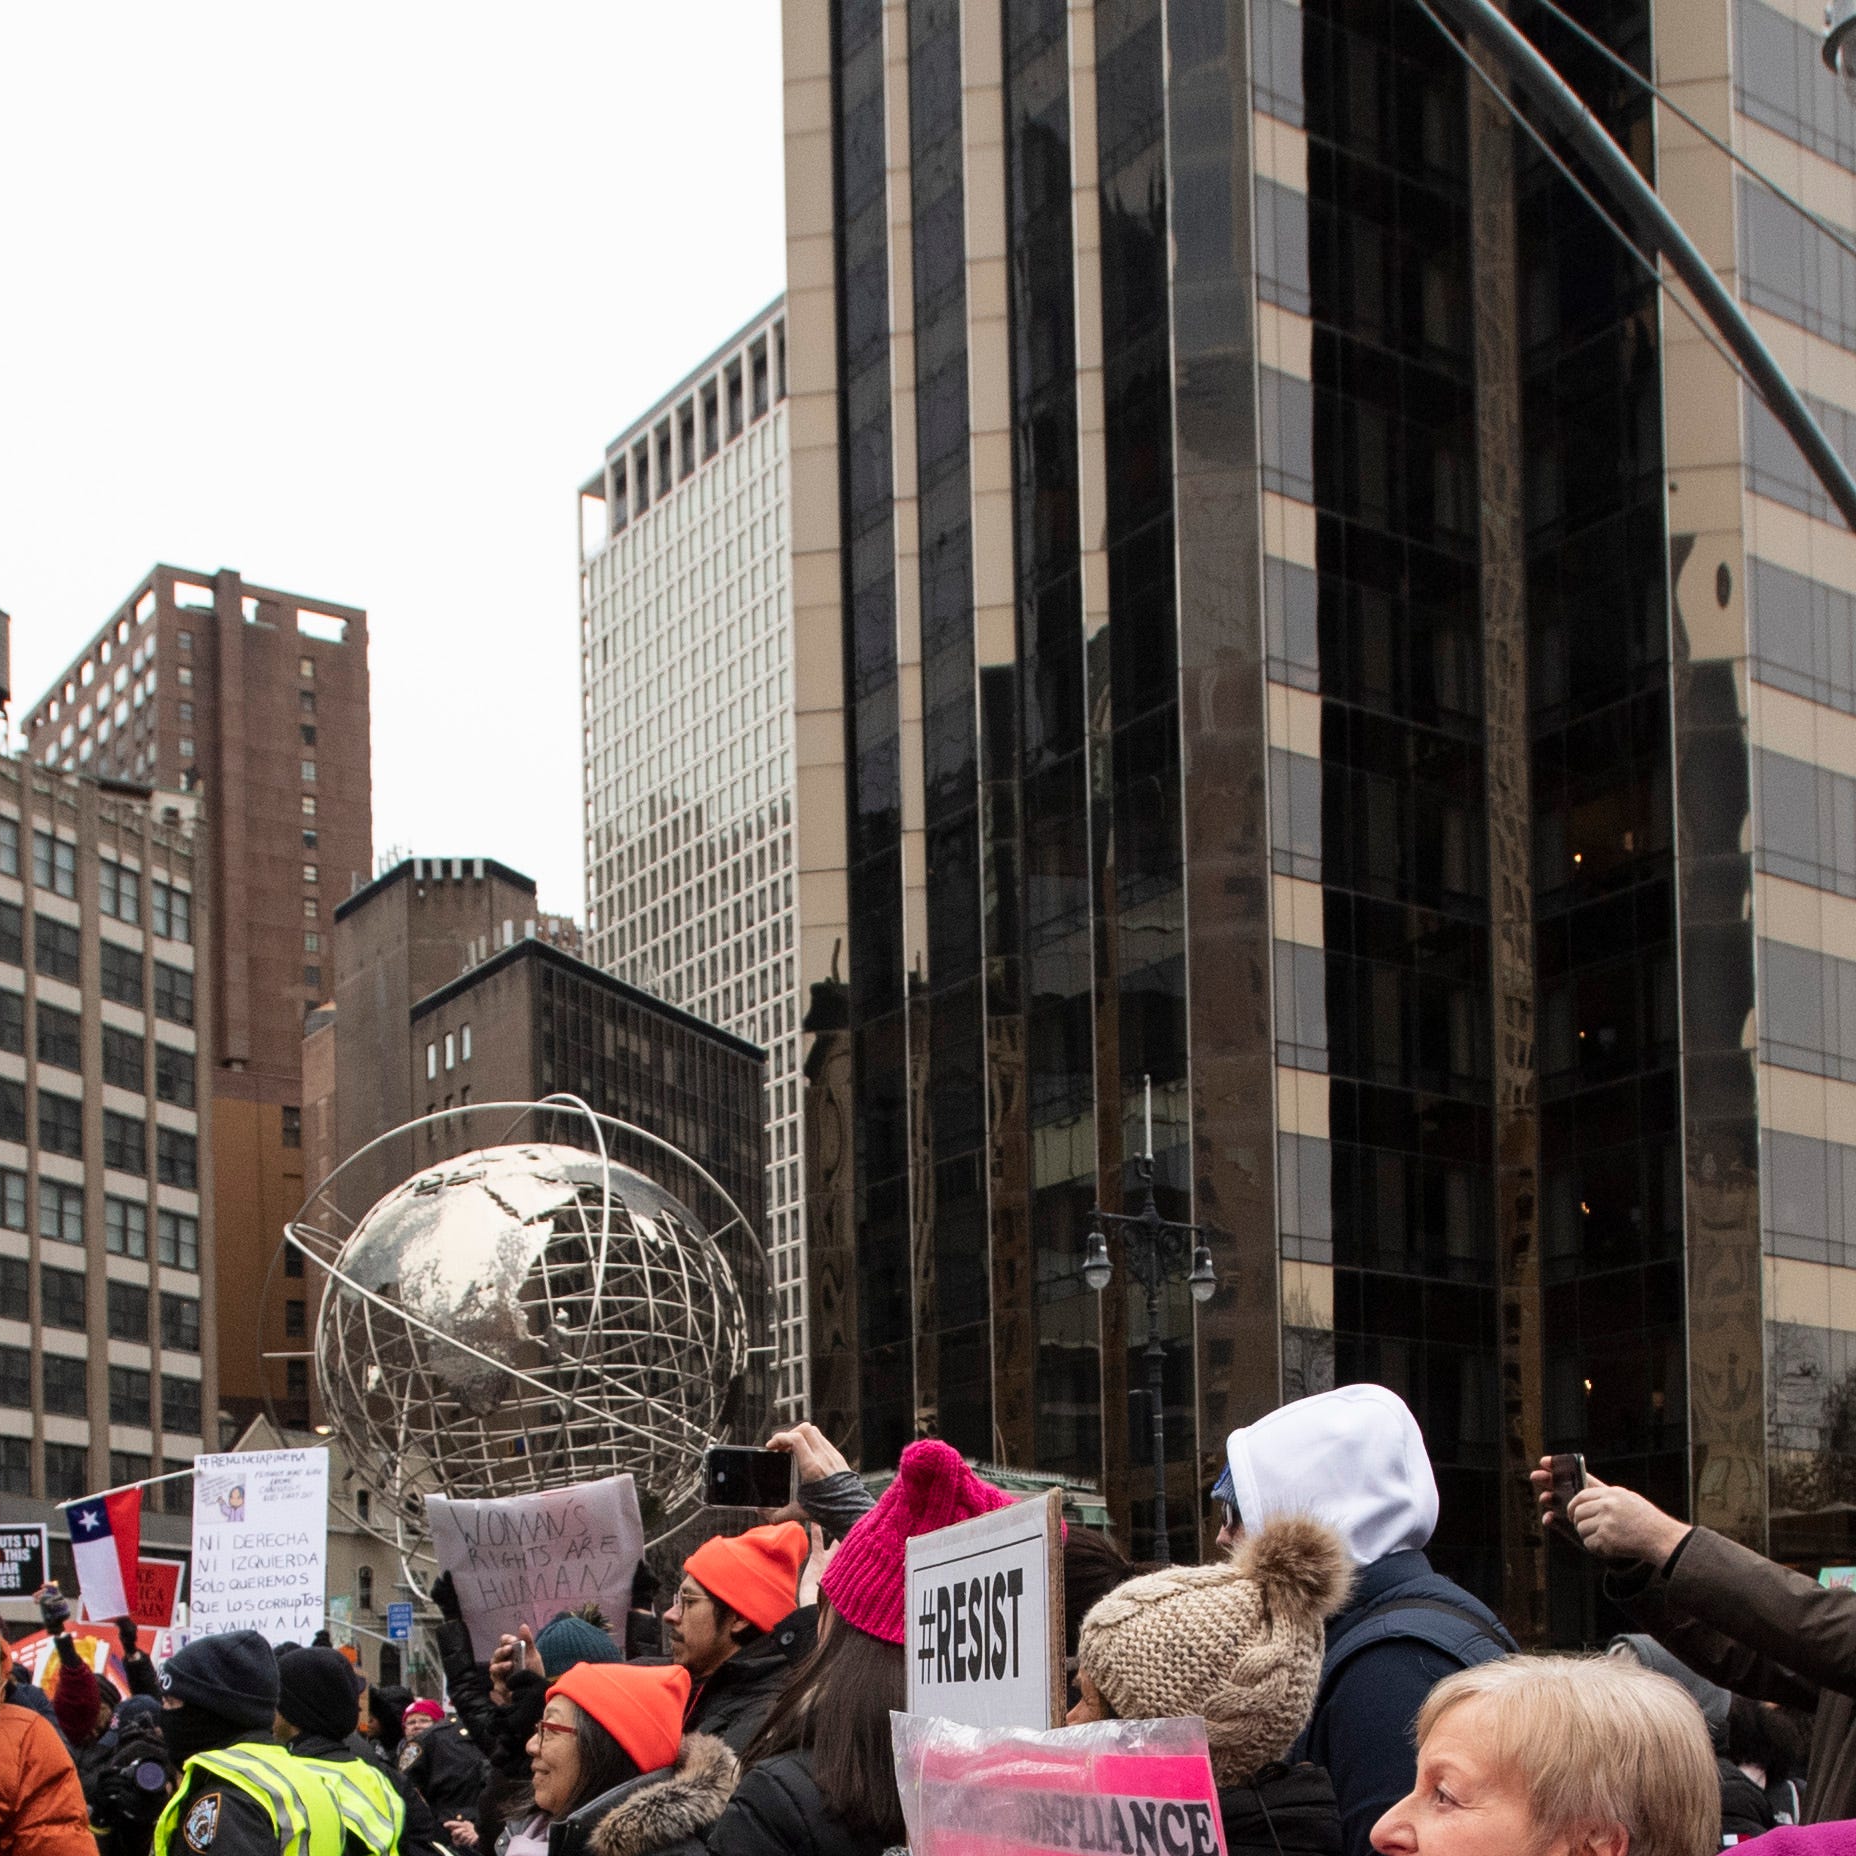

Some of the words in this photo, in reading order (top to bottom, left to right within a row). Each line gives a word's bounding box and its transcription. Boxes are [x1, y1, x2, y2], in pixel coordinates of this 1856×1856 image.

[449, 1498, 590, 1546] WOMAN'S
[24, 1534, 40, 1548] TO
[233, 1532, 309, 1549] DERECHA
[3, 1548, 32, 1561] THIS
[468, 1544, 551, 1570] RIGHTS
[564, 1535, 619, 1561] ARE
[192, 1578, 225, 1593] SOLO
[229, 1573, 309, 1590] QUEREMOS
[477, 1561, 613, 1608] HUMAN
[192, 1600, 219, 1614] QUE
[193, 1622, 215, 1635] SE
[276, 1616, 287, 1629] A
[294, 1615, 311, 1629] LA
[918, 1567, 1023, 1685] #RESIST
